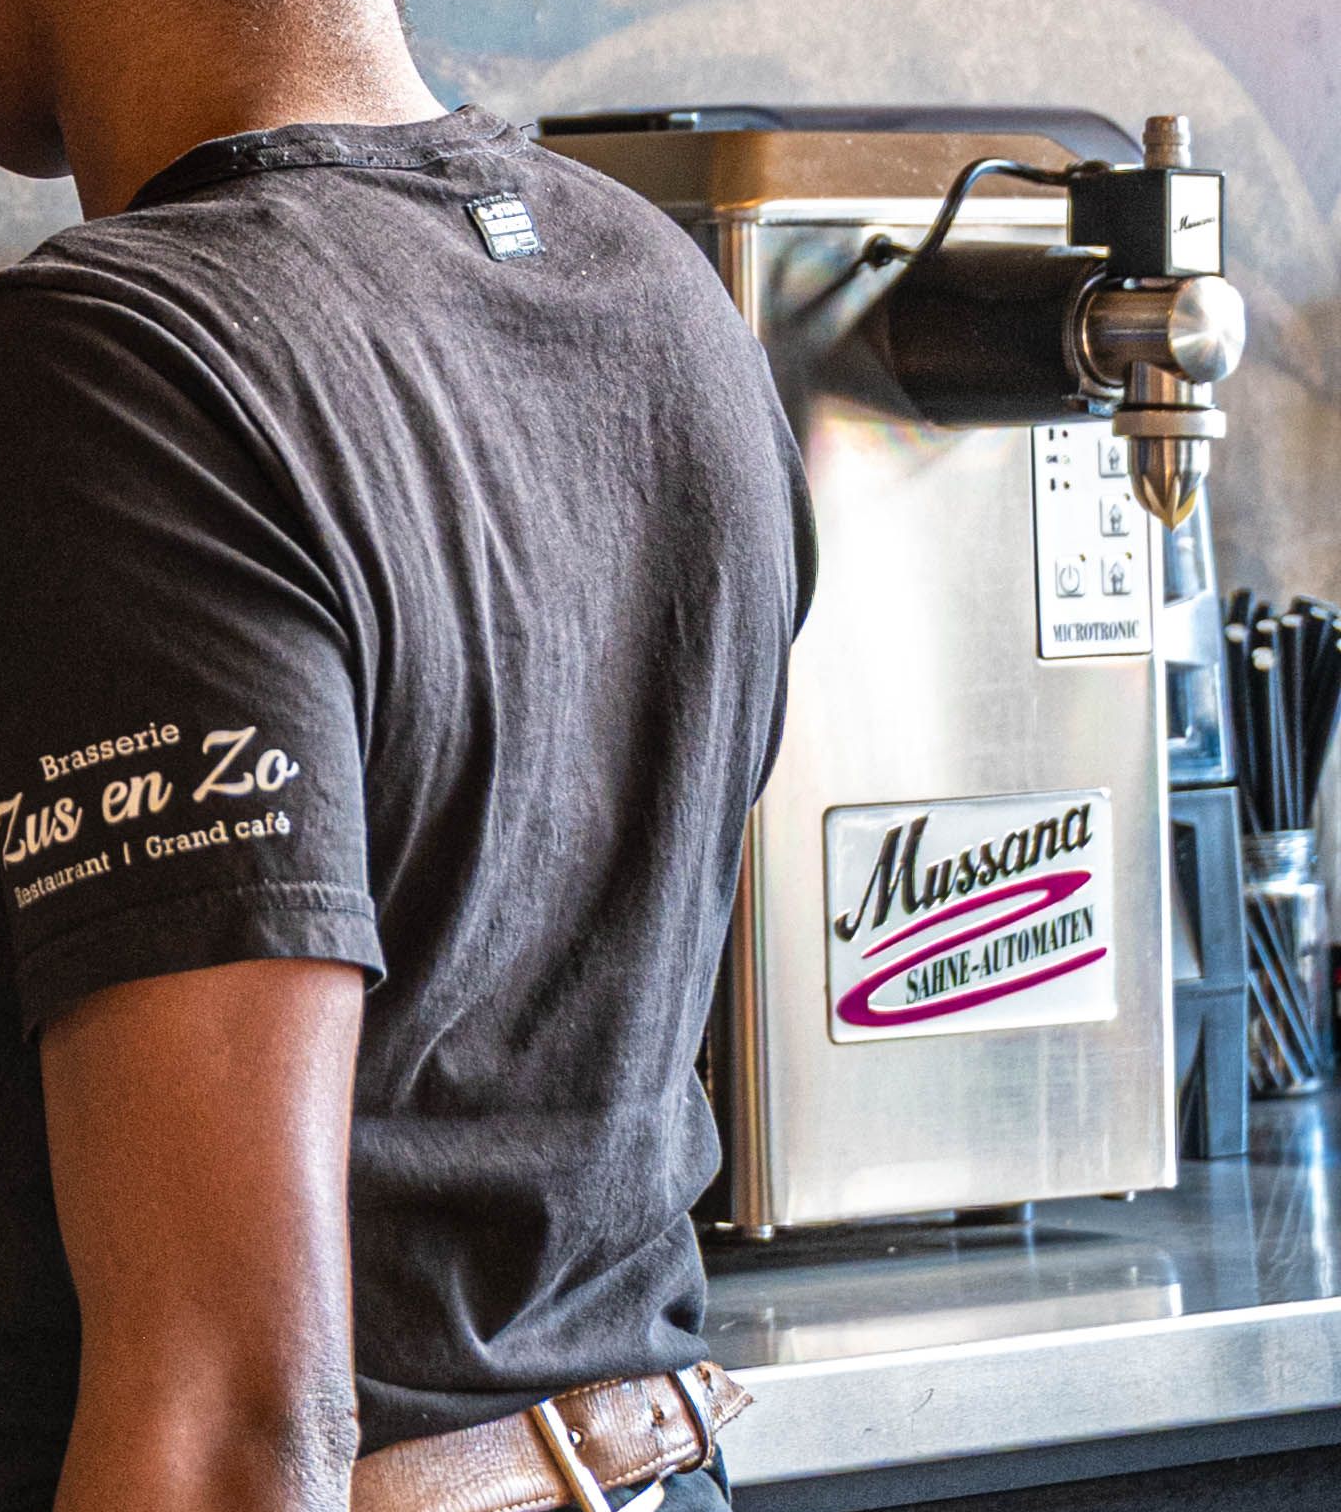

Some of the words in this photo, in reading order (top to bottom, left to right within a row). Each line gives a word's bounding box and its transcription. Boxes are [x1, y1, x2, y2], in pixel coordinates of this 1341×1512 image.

[1051, 619, 1140, 644] MICROTRONIC
[38, 722, 181, 782] Brasserie
[101, 770, 174, 825] en
[191, 725, 301, 805] Zo
[144, 820, 230, 859] Grand
[833, 801, 1094, 944] Mussana
[904, 904, 1096, 1005] SAHNE-AUTOMATEN
